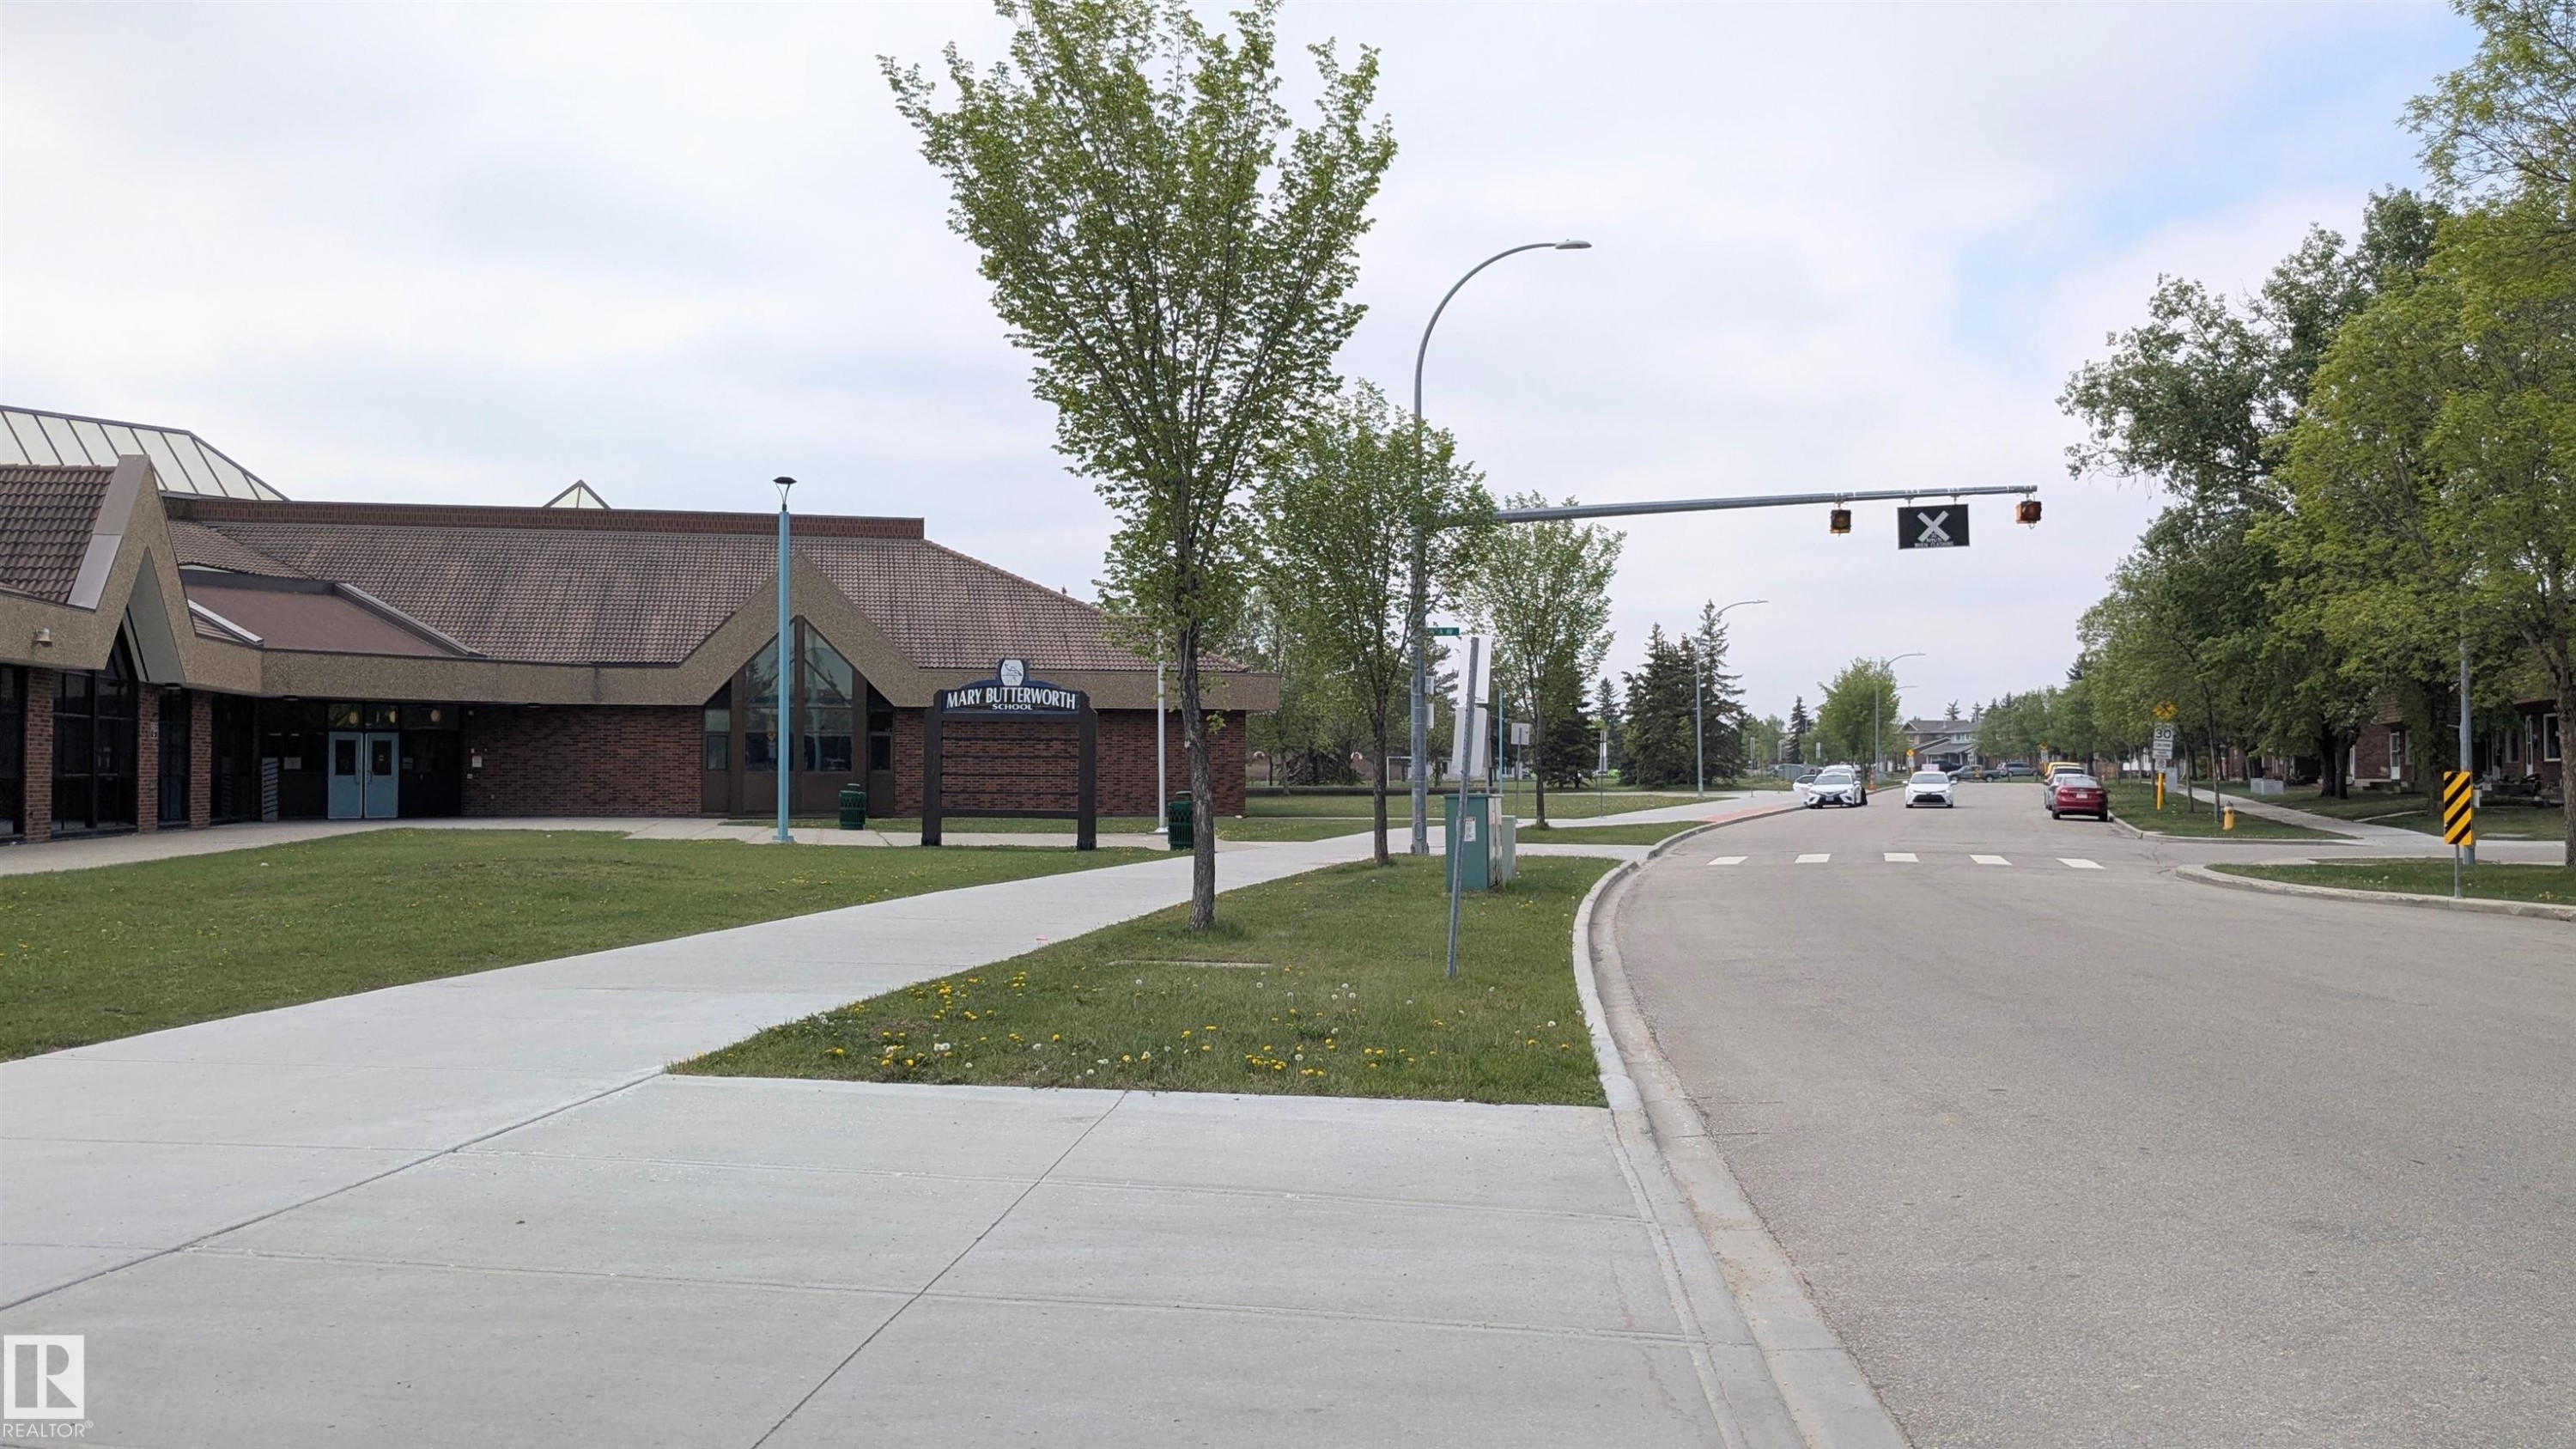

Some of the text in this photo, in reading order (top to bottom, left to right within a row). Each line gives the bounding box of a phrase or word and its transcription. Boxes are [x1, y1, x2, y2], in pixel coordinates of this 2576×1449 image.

[946, 687, 1076, 709] MARY BUTTERWORTH
[2155, 729, 2172, 739] 30
